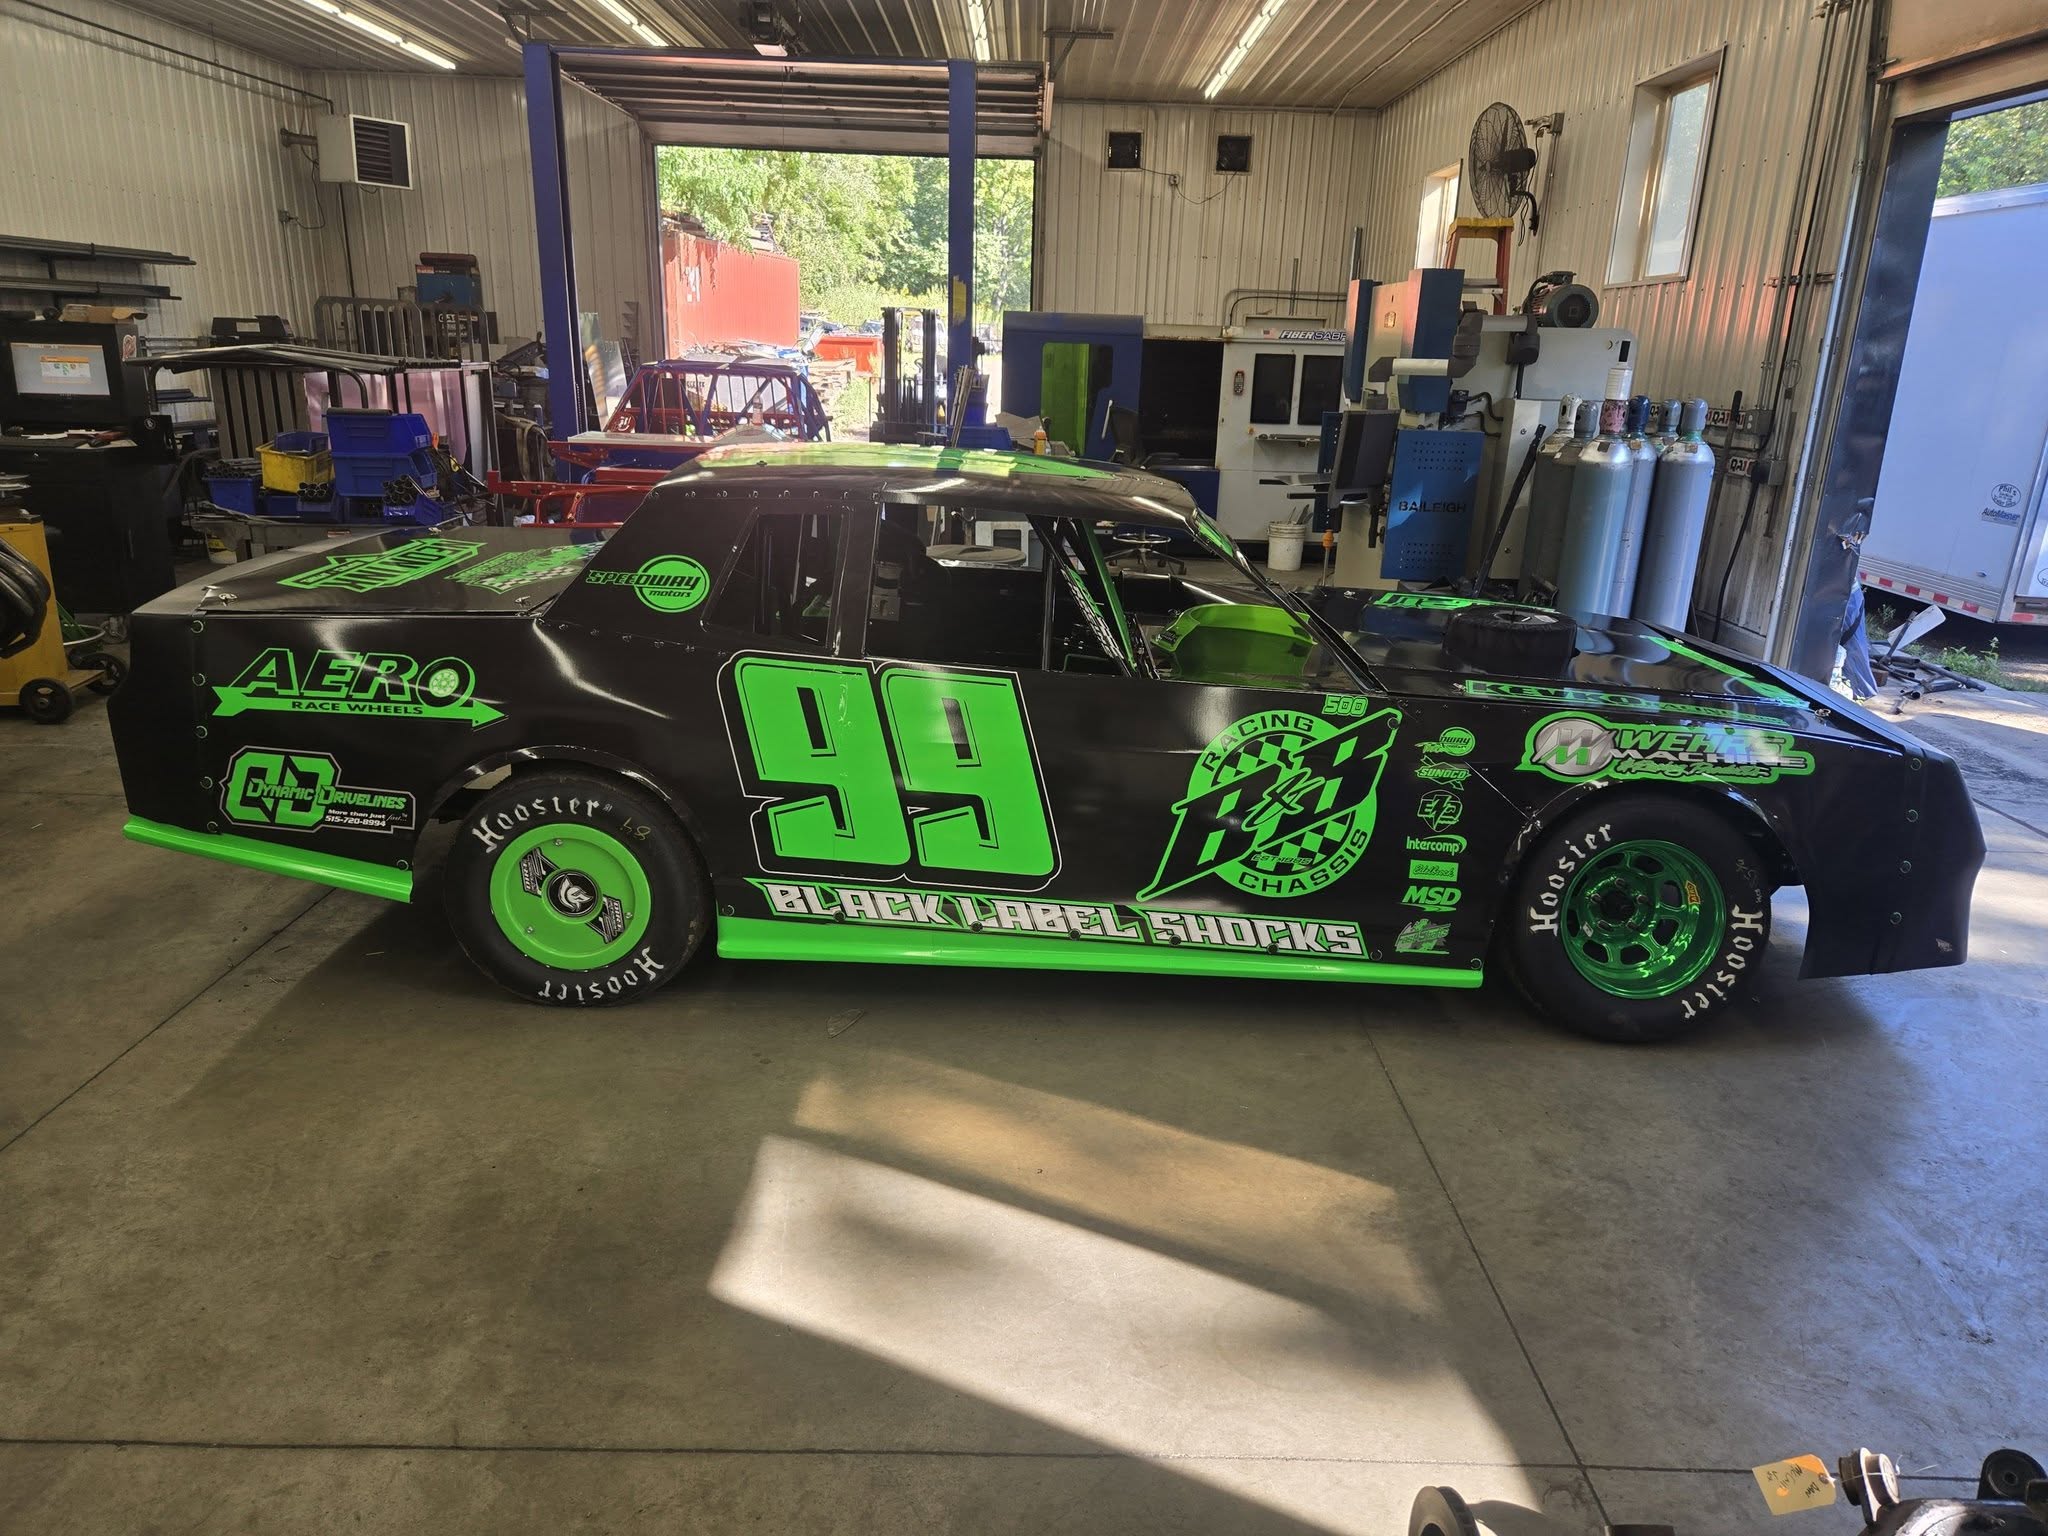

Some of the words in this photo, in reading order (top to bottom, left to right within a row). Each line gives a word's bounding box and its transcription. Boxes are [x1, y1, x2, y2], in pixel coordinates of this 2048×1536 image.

[1398, 500, 1466, 513] BAILEIGH
[586, 569, 701, 591] SPEEDWAY
[649, 590, 692, 598] motors
[228, 648, 477, 709] AERO
[291, 700, 340, 712] RACE
[346, 702, 424, 716] WHEELS
[1322, 694, 1369, 717] 500
[1200, 713, 1315, 773] RACING
[1619, 730, 1787, 756] WEHRS
[734, 657, 1054, 876] 99
[1609, 747, 1806, 768] MACHINE
[1419, 768, 1467, 779] SUNOCO
[324, 815, 387, 827] 515-720-8994
[472, 796, 600, 854] Hoosier
[1406, 835, 1460, 856] Intercomp
[1237, 828, 1369, 894] CHASSIS
[1529, 823, 1611, 937] Hoosier
[1402, 885, 1462, 906] MSD
[764, 883, 949, 926] BLACK
[955, 896, 1140, 939] LABEL
[1145, 910, 1364, 955] SHOCKS
[1682, 904, 1764, 1019] Hoosier
[537, 947, 665, 1002] Hoosier
